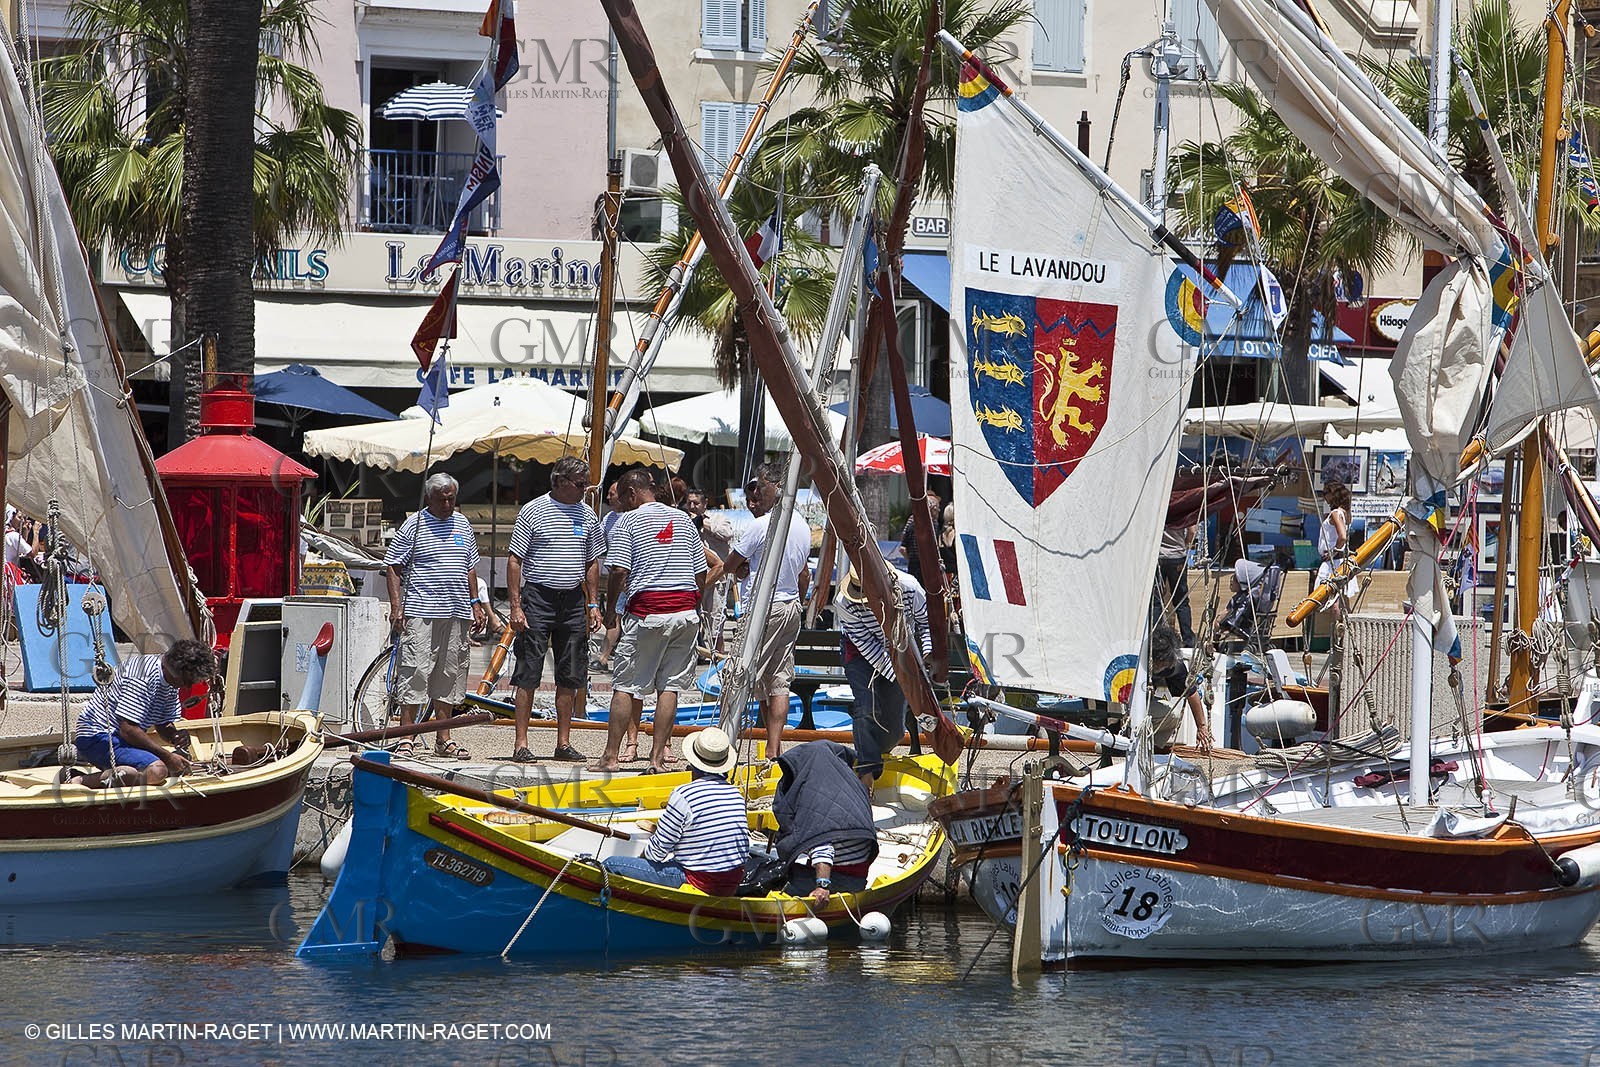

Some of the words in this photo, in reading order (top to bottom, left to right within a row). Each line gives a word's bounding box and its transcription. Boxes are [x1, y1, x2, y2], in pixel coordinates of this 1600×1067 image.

[916, 218, 946, 234] BAR
[384, 241, 443, 285] La
[979, 251, 999, 273] LE
[1010, 255, 1106, 284] LAVANDOU
[1236, 340, 1271, 355] LOTO
[416, 367, 475, 385] CFE
[488, 367, 514, 384] LA
[1085, 818, 1176, 850] TOULON
[1101, 868, 1141, 895] Voiles
[1145, 868, 1174, 909] Latines
[1113, 886, 1160, 921] 18
